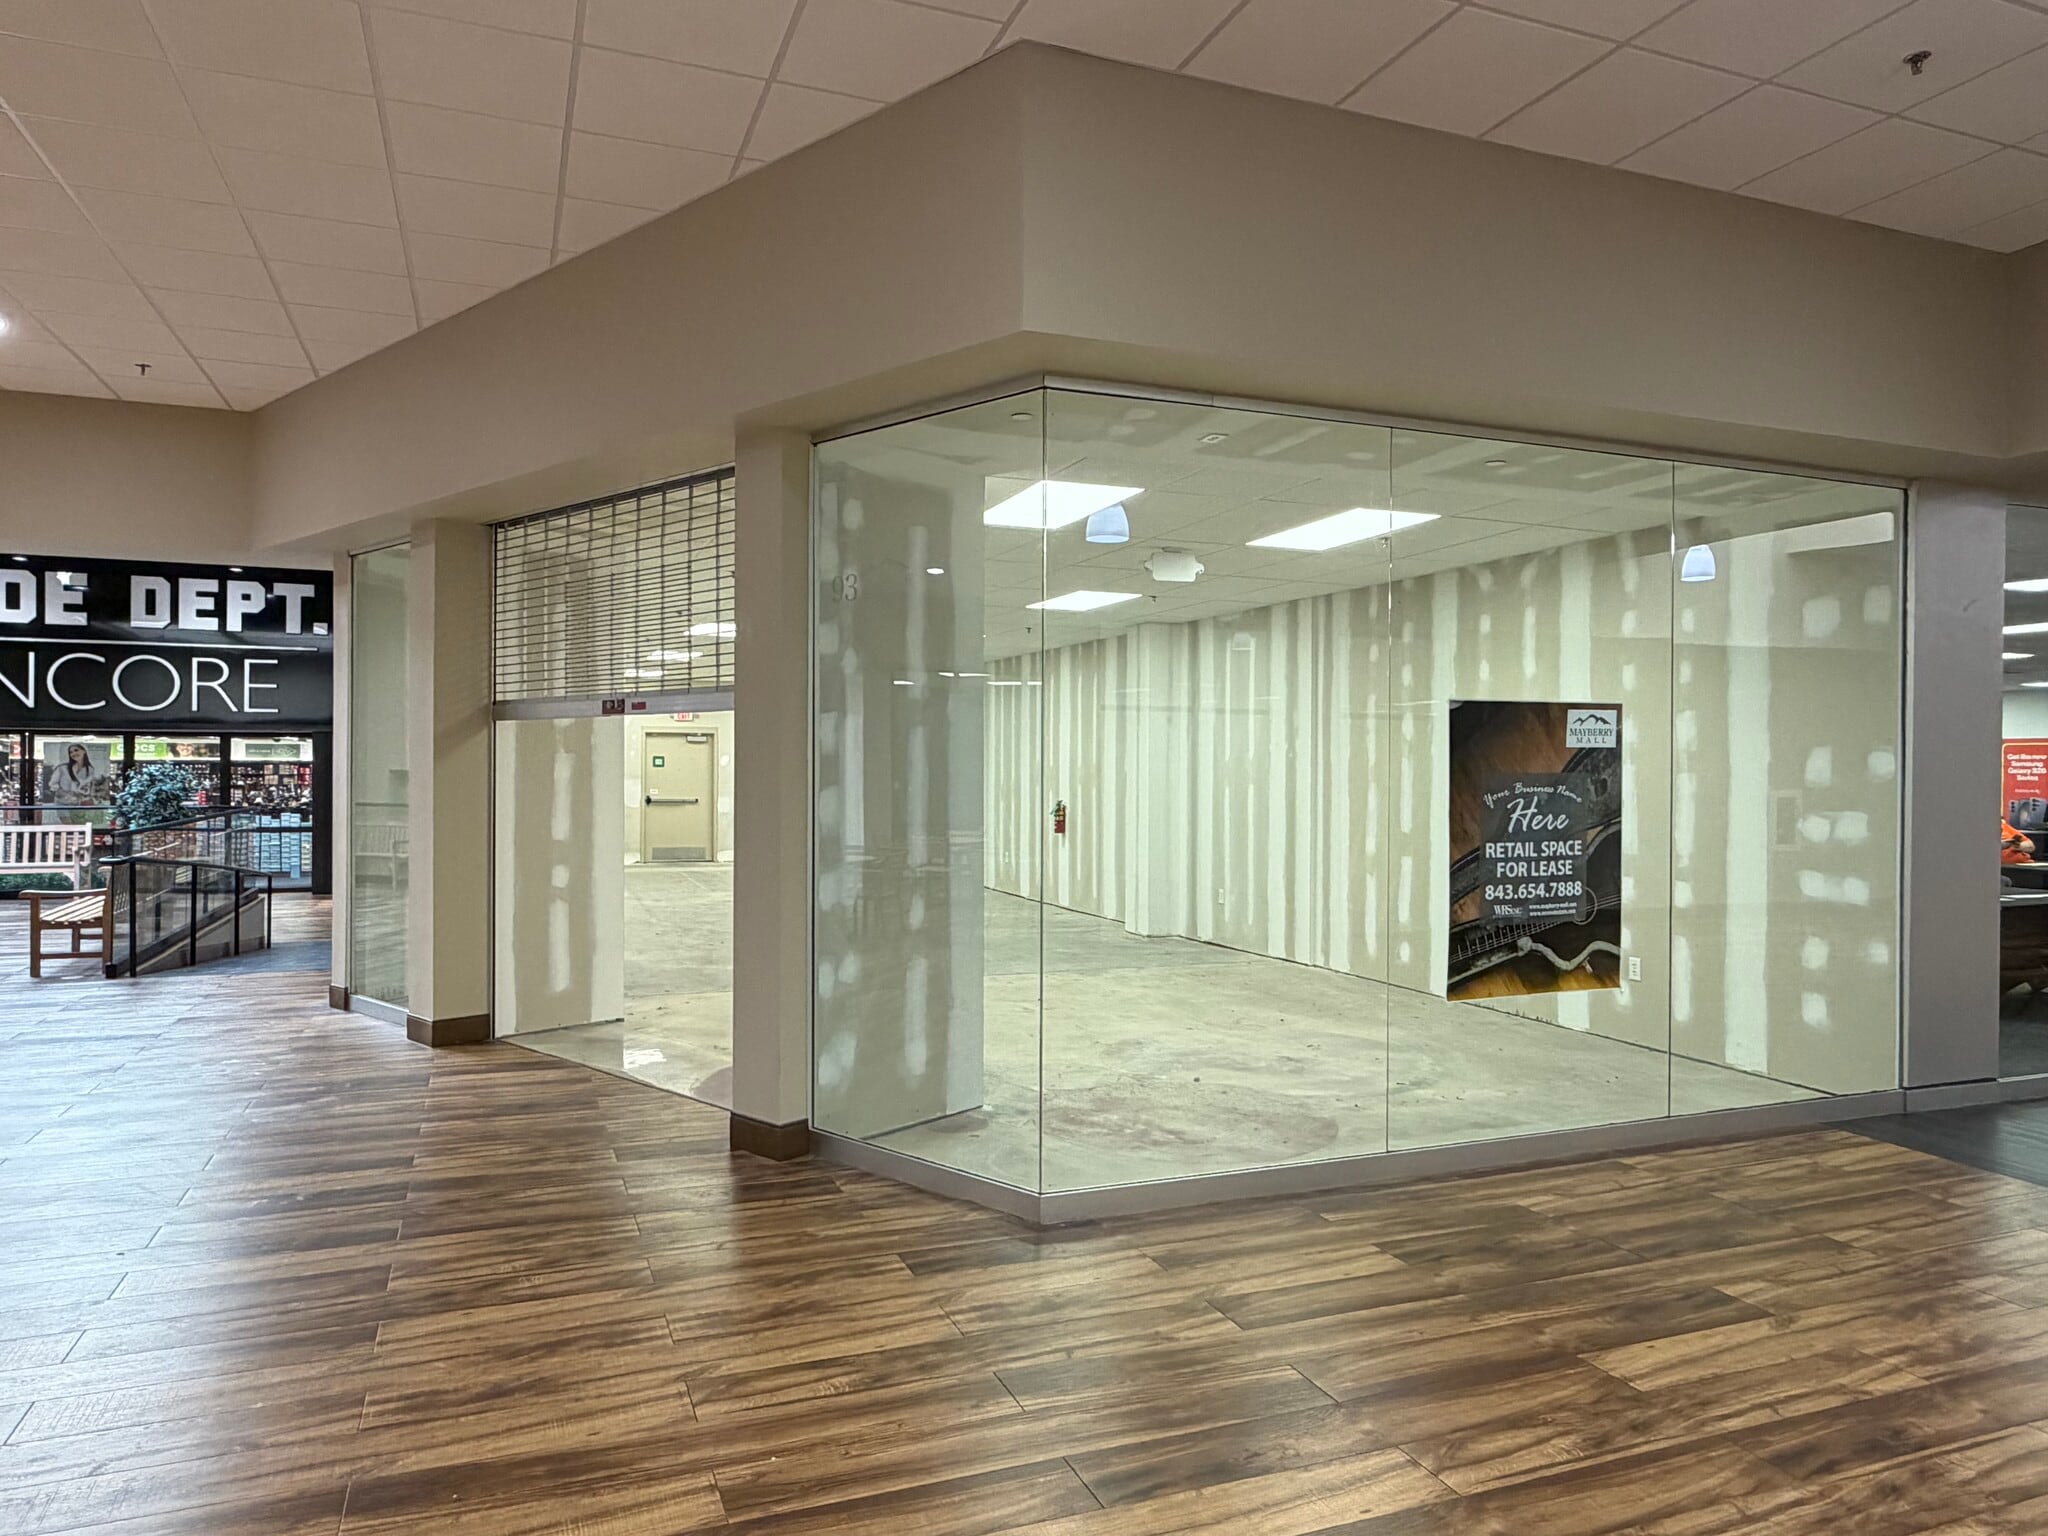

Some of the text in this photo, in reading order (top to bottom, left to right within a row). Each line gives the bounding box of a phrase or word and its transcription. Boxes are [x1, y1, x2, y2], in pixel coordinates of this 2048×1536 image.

[130, 575, 329, 636] DEPT.
[1569, 727, 1613, 737] MAYBERRY
[1576, 736, 1607, 744] MALL
[1483, 782, 1583, 809] Your Business Name
[1506, 795, 1569, 833] Here
[1485, 840, 1583, 859] RETAIL SPACE
[1496, 859, 1574, 878] FOR LEASE
[1484, 880, 1583, 900] 843.654.7888
